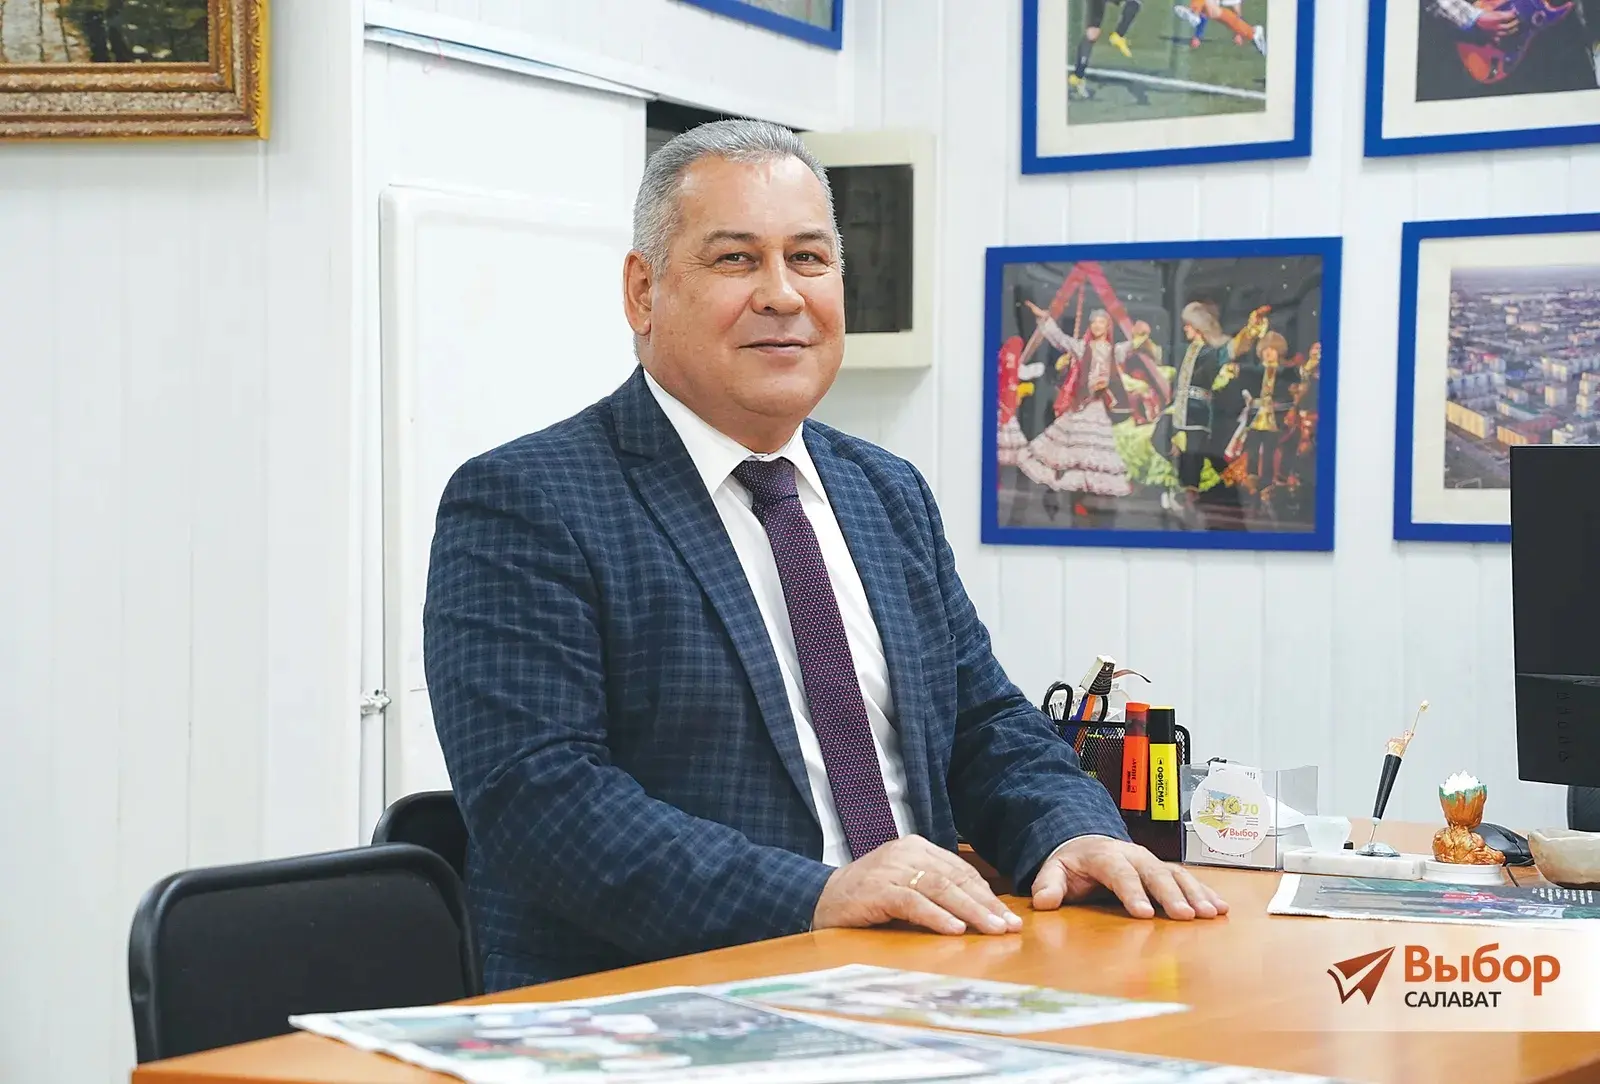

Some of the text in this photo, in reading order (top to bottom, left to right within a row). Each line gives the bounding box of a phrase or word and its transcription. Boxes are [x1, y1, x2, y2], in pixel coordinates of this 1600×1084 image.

[1157, 766, 1165, 808] ОФИСМАГ
[1242, 803, 1259, 815] 70
[1229, 828, 1259, 840] Выбор
